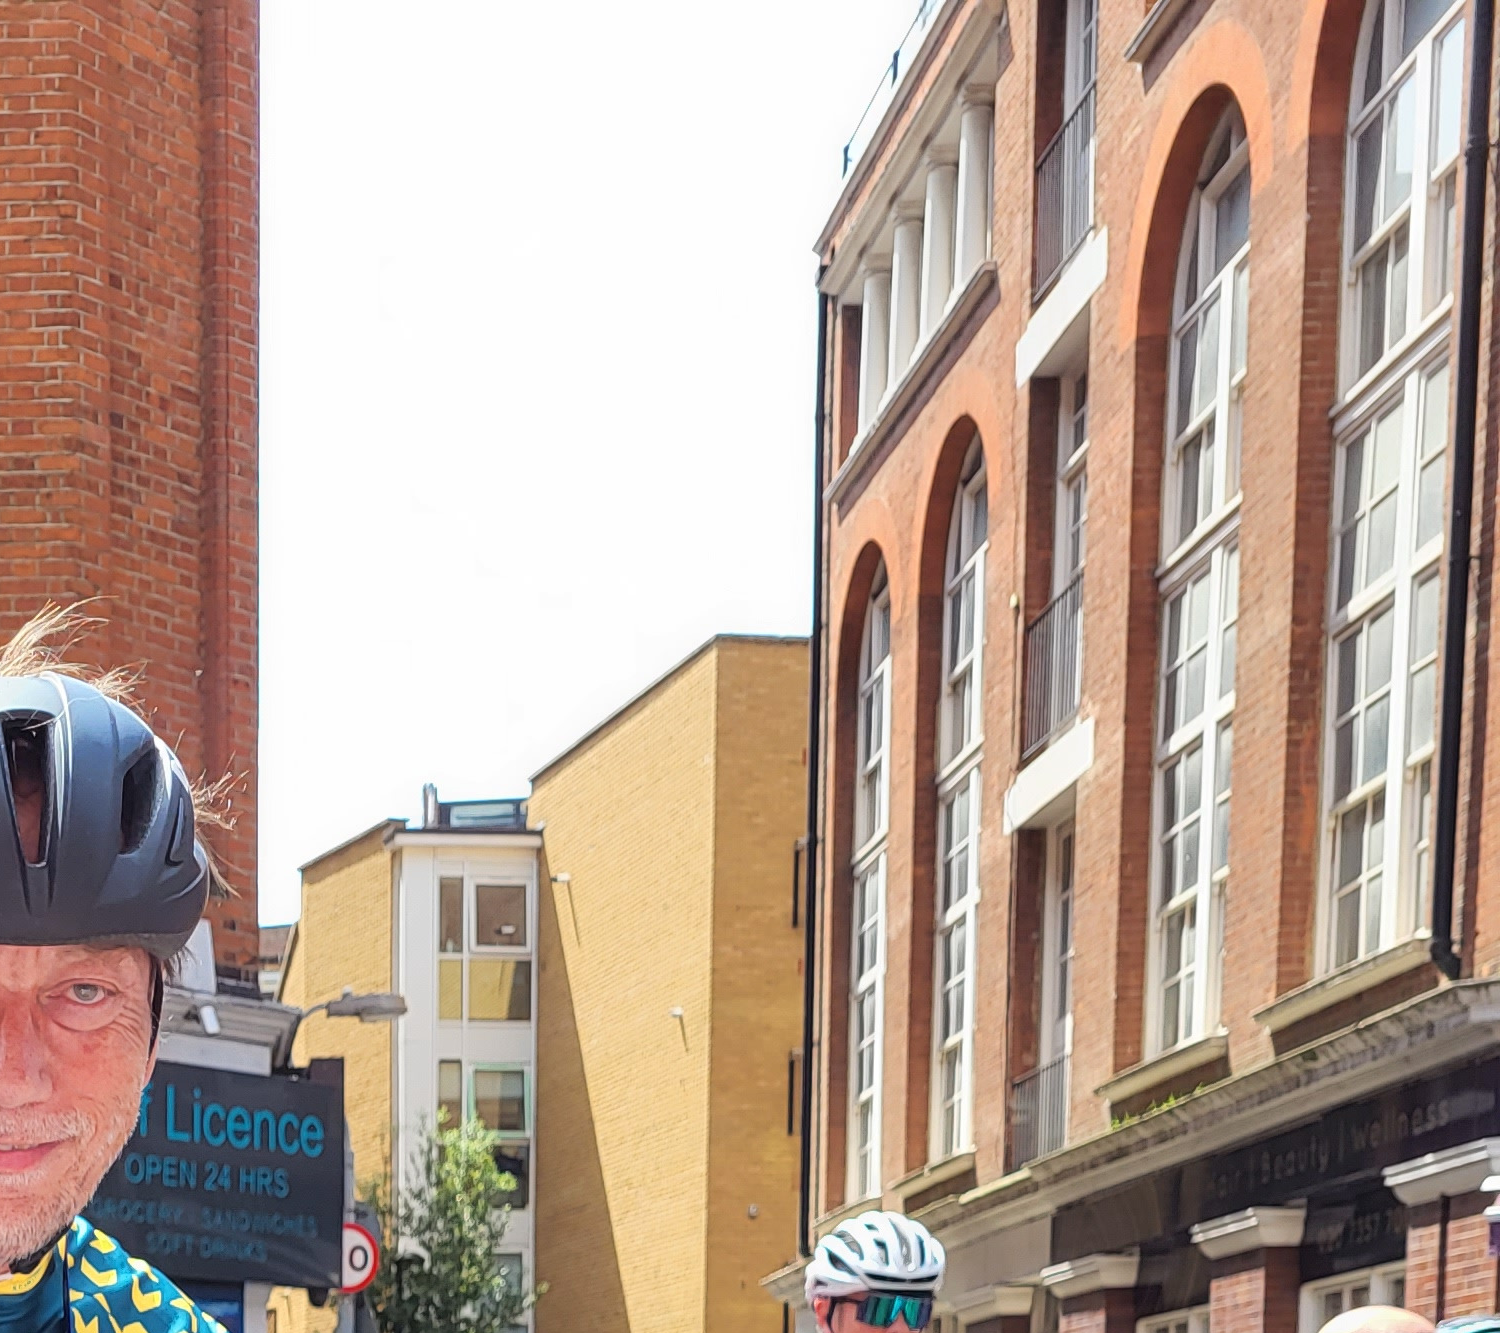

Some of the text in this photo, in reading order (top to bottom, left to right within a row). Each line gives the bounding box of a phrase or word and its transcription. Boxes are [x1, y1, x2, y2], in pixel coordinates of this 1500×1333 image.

[165, 1083, 325, 1158] Licence
[123, 1153, 290, 1199] OPEN 24 HRS
